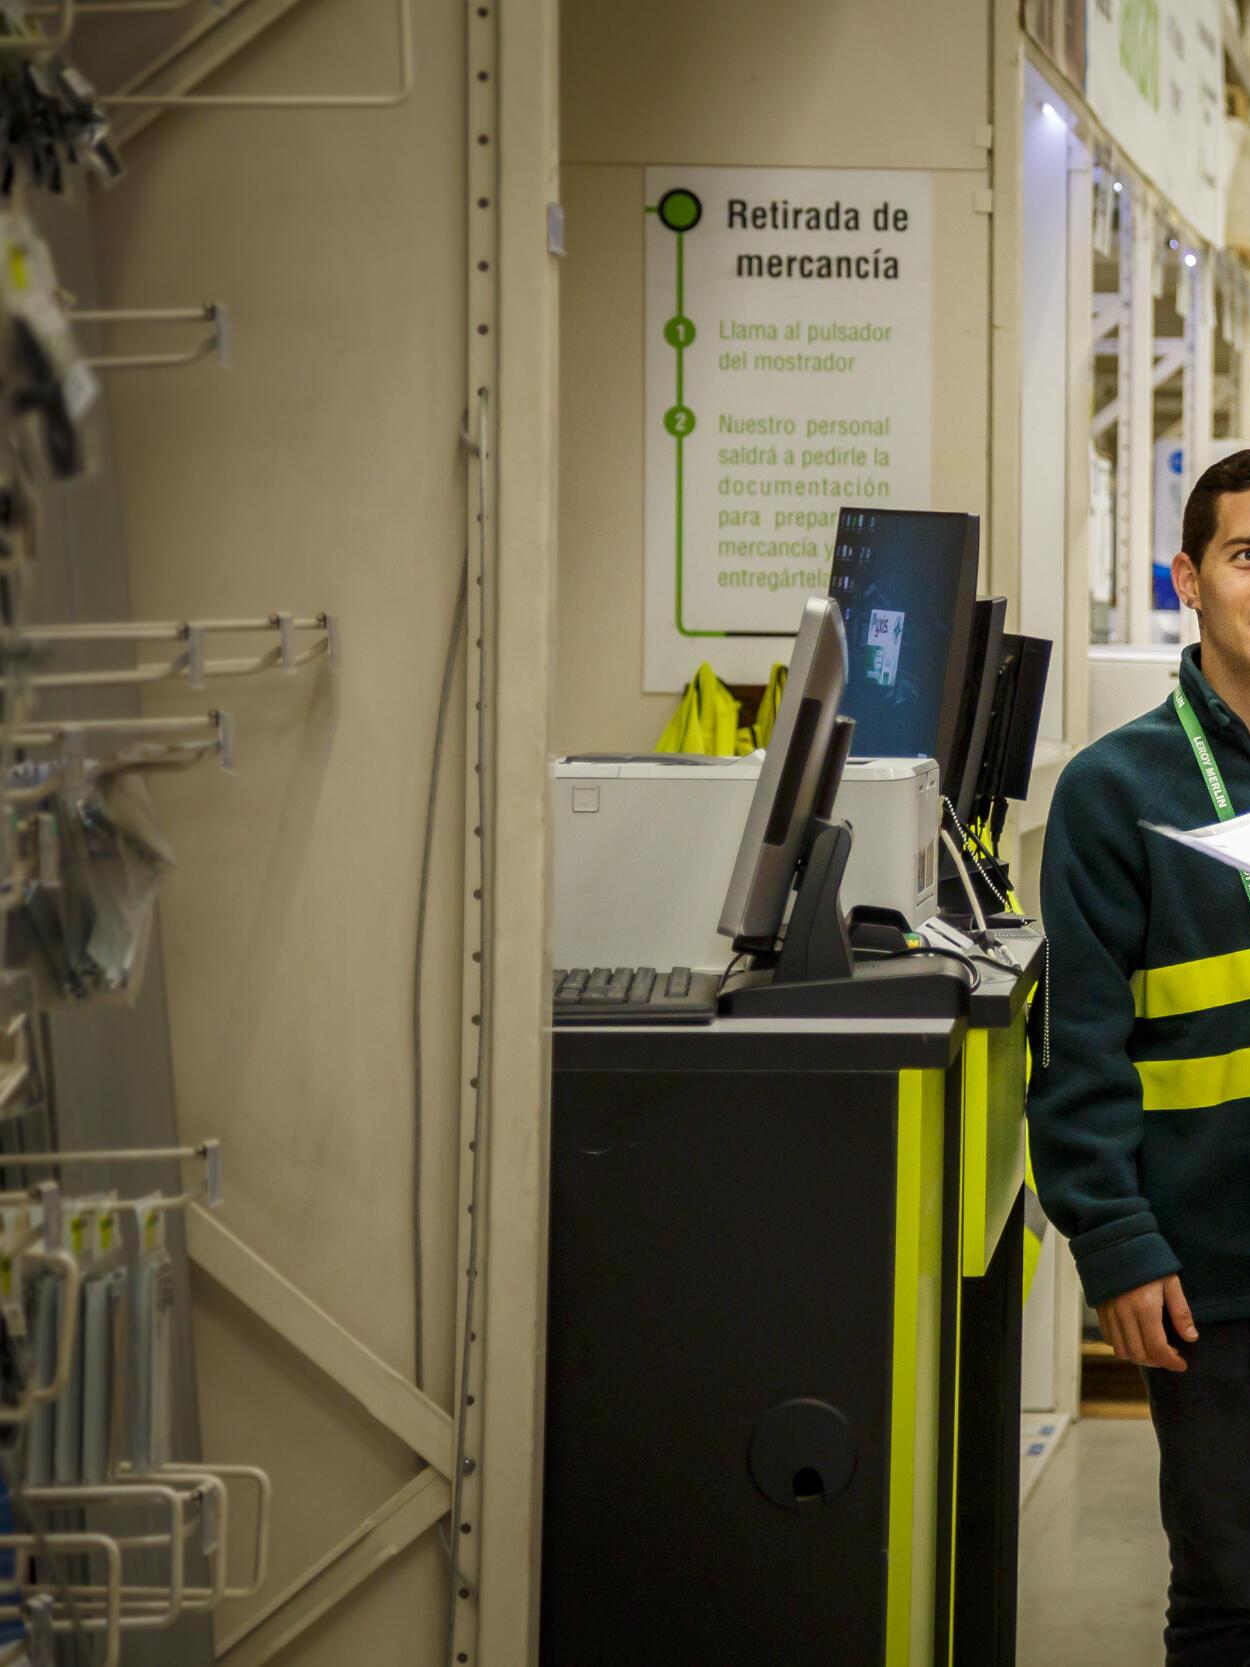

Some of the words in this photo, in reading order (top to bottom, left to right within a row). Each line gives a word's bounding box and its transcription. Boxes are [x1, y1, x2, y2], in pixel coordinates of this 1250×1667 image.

[727, 199, 859, 231] Retirada
[874, 202, 908, 232] de
[736, 249, 899, 279] mercancía
[676, 324, 686, 341] 1
[719, 319, 778, 341] Llama
[784, 321, 801, 341] al
[807, 321, 892, 345] pulsador
[719, 352, 747, 371] del
[754, 352, 855, 373] mostrador
[675, 412, 688, 431] 2
[719, 415, 795, 435] Nuestro
[806, 416, 890, 440] personal
[719, 444, 777, 466] saldrá
[783, 449, 796, 466] a
[801, 447, 868, 470] pedirle
[874, 448, 891, 467] la
[718, 474, 891, 498] documentación
[718, 510, 761, 529] para
[775, 510, 838, 530] prepar
[718, 537, 818, 558] mercancía
[1193, 735, 1213, 766] LEROY
[1205, 766, 1228, 808] MERLIN
